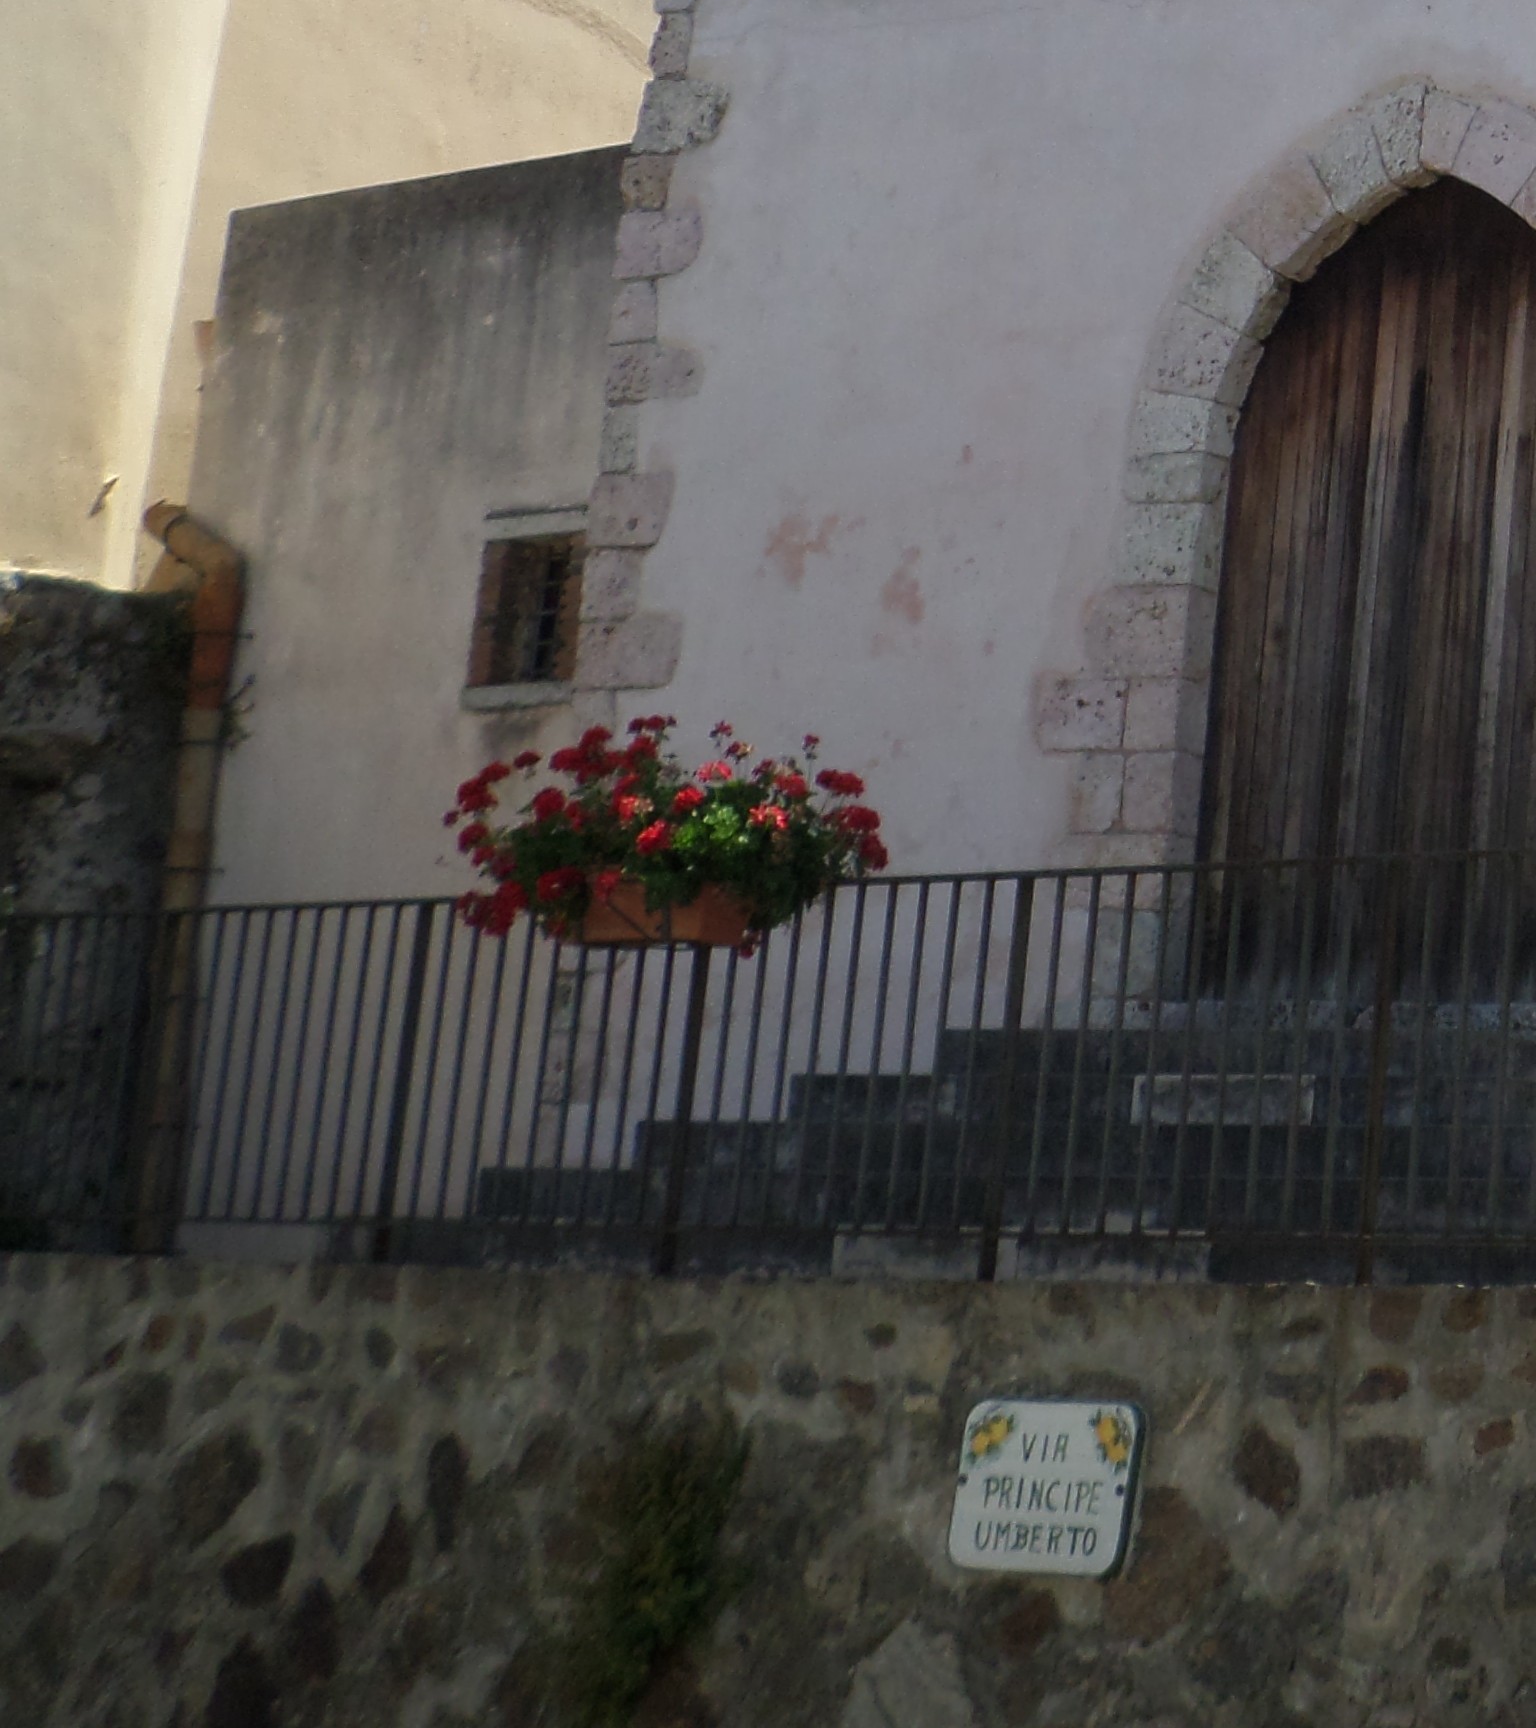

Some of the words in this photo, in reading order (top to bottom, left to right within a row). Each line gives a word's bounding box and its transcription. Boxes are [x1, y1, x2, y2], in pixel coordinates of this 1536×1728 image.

[1022, 1432, 1070, 1462] VIA
[983, 1474, 1104, 1515] PRINCIPE
[974, 1520, 1098, 1557] UMBERTO
